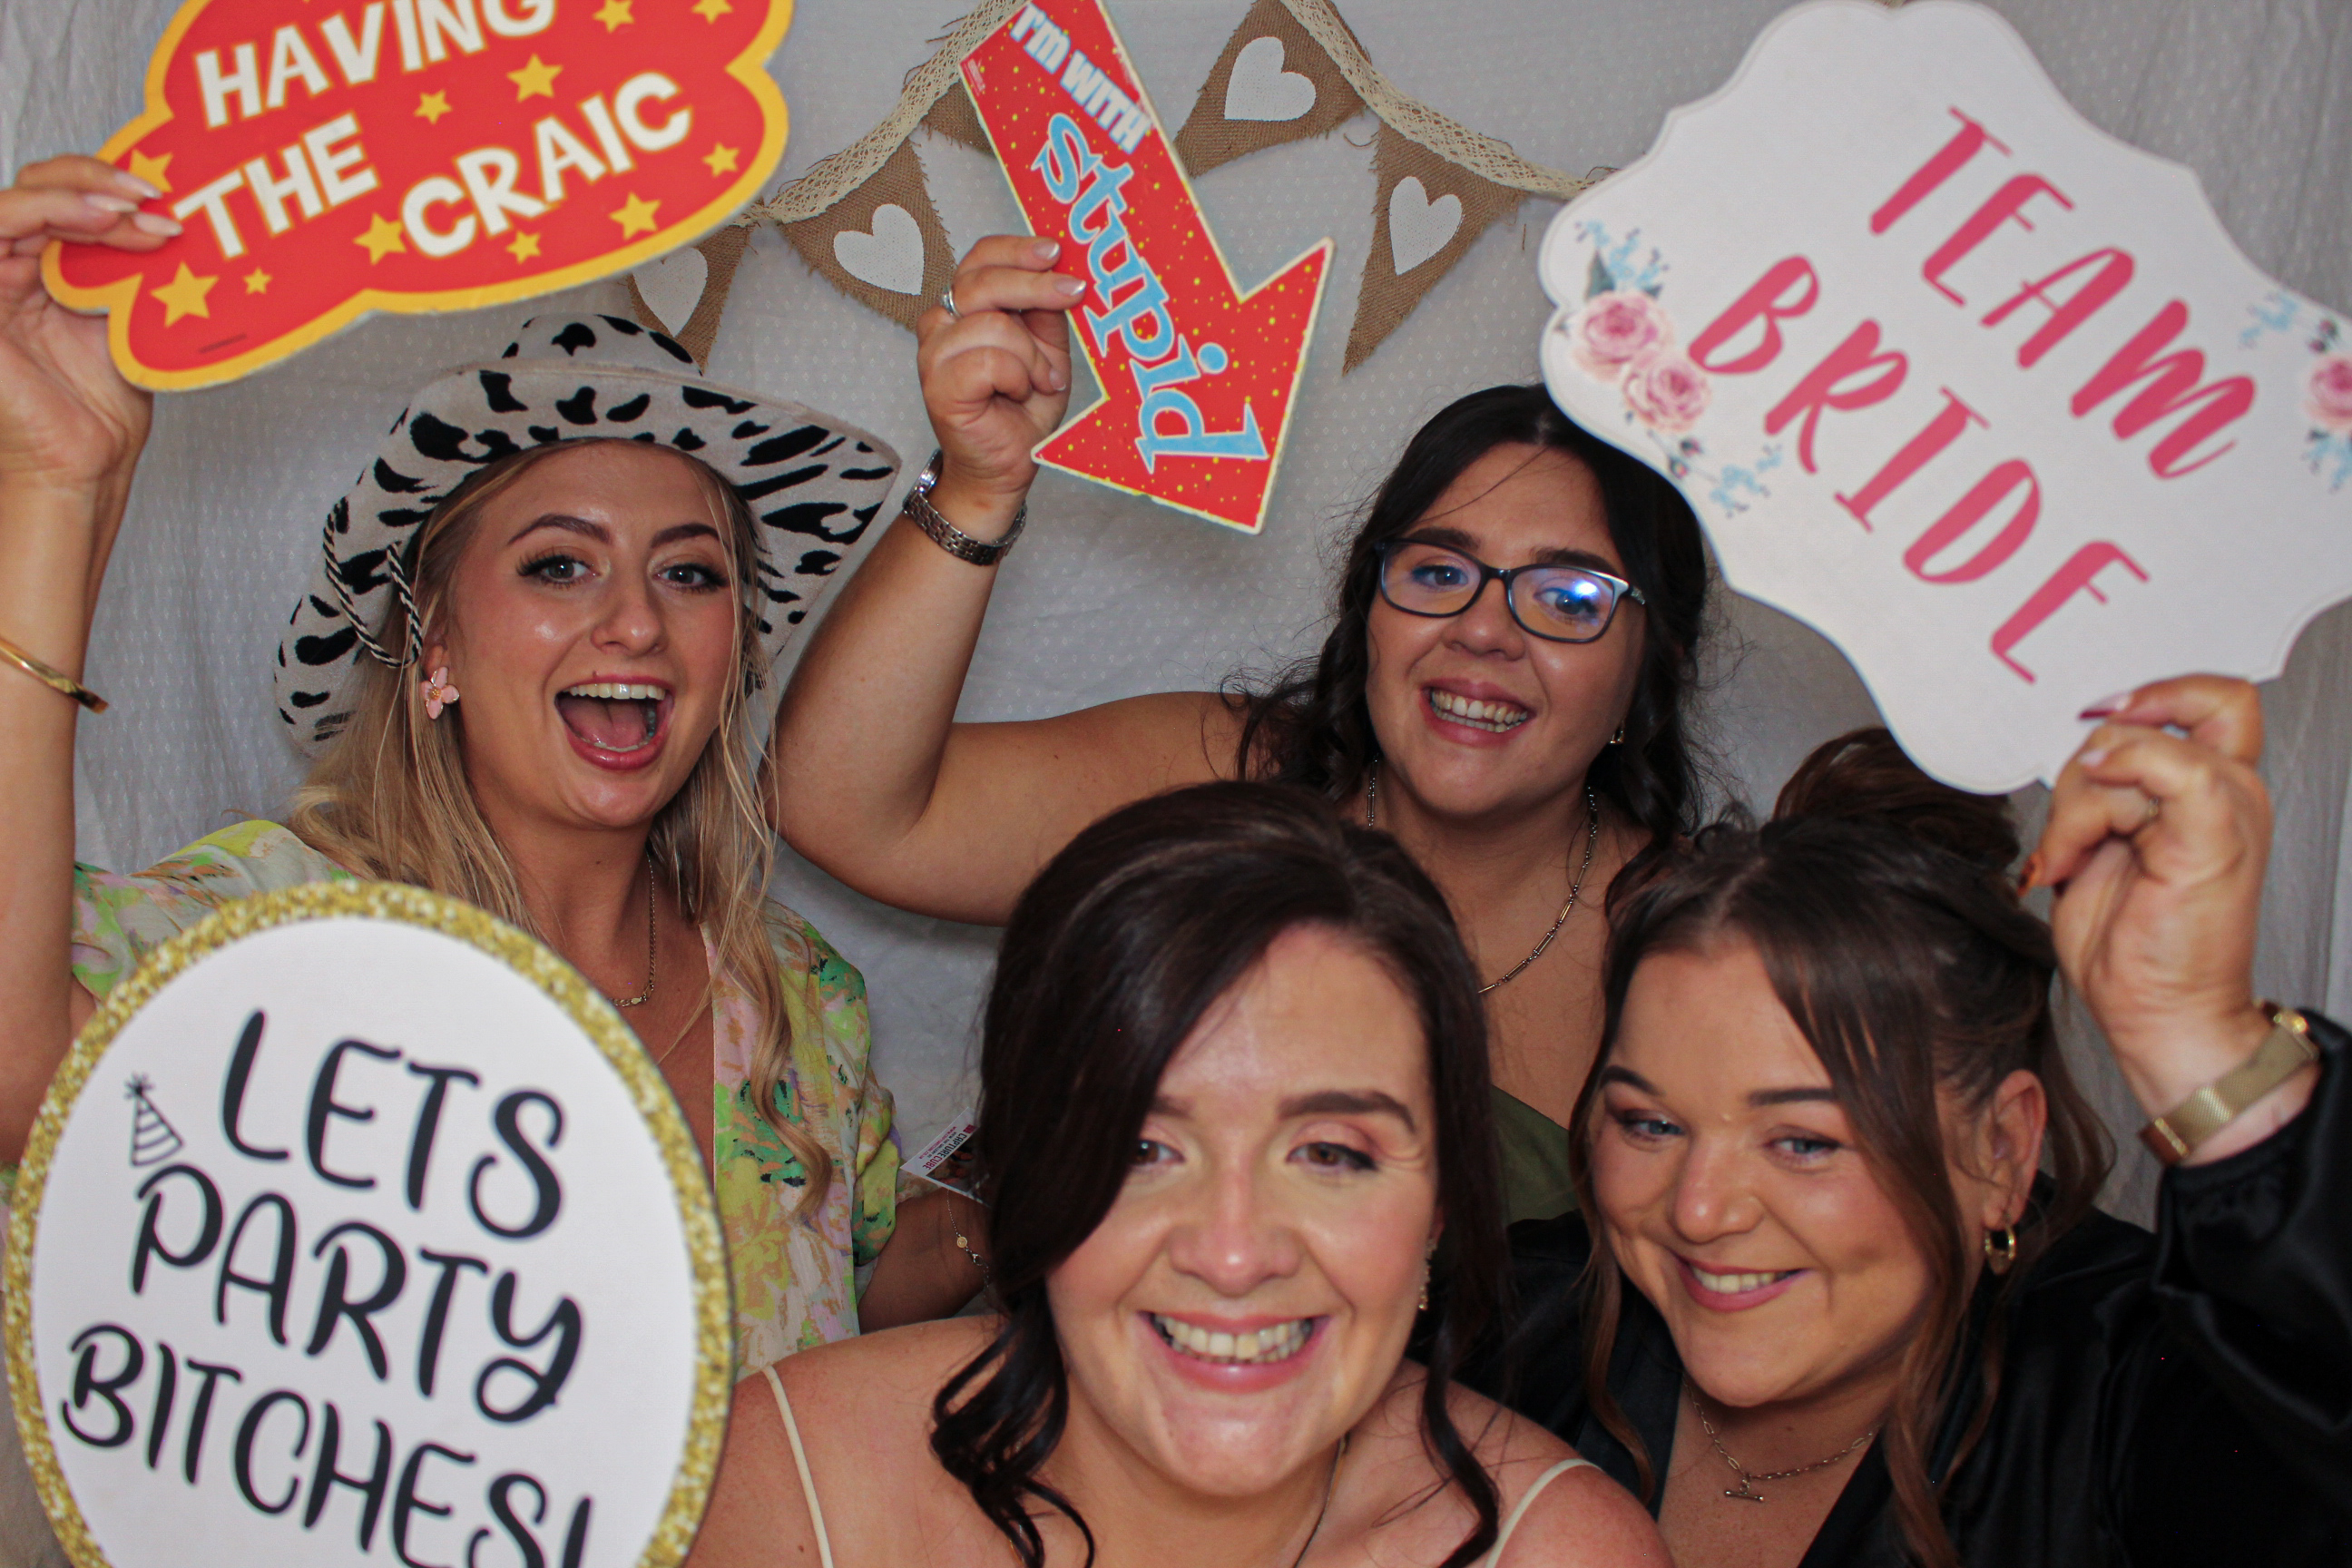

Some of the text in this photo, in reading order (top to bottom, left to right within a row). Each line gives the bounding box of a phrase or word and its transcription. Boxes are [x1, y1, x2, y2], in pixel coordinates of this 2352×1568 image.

[173, 73, 691, 258] THE CRAIC
[197, 0, 555, 127] HAVING
[1059, 49, 1154, 154] WITH
[1869, 106, 2256, 480] TEAM
[1687, 255, 2150, 684] BRIDE
[221, 1009, 565, 1241] LETS
[131, 1162, 583, 1425] PARTY
